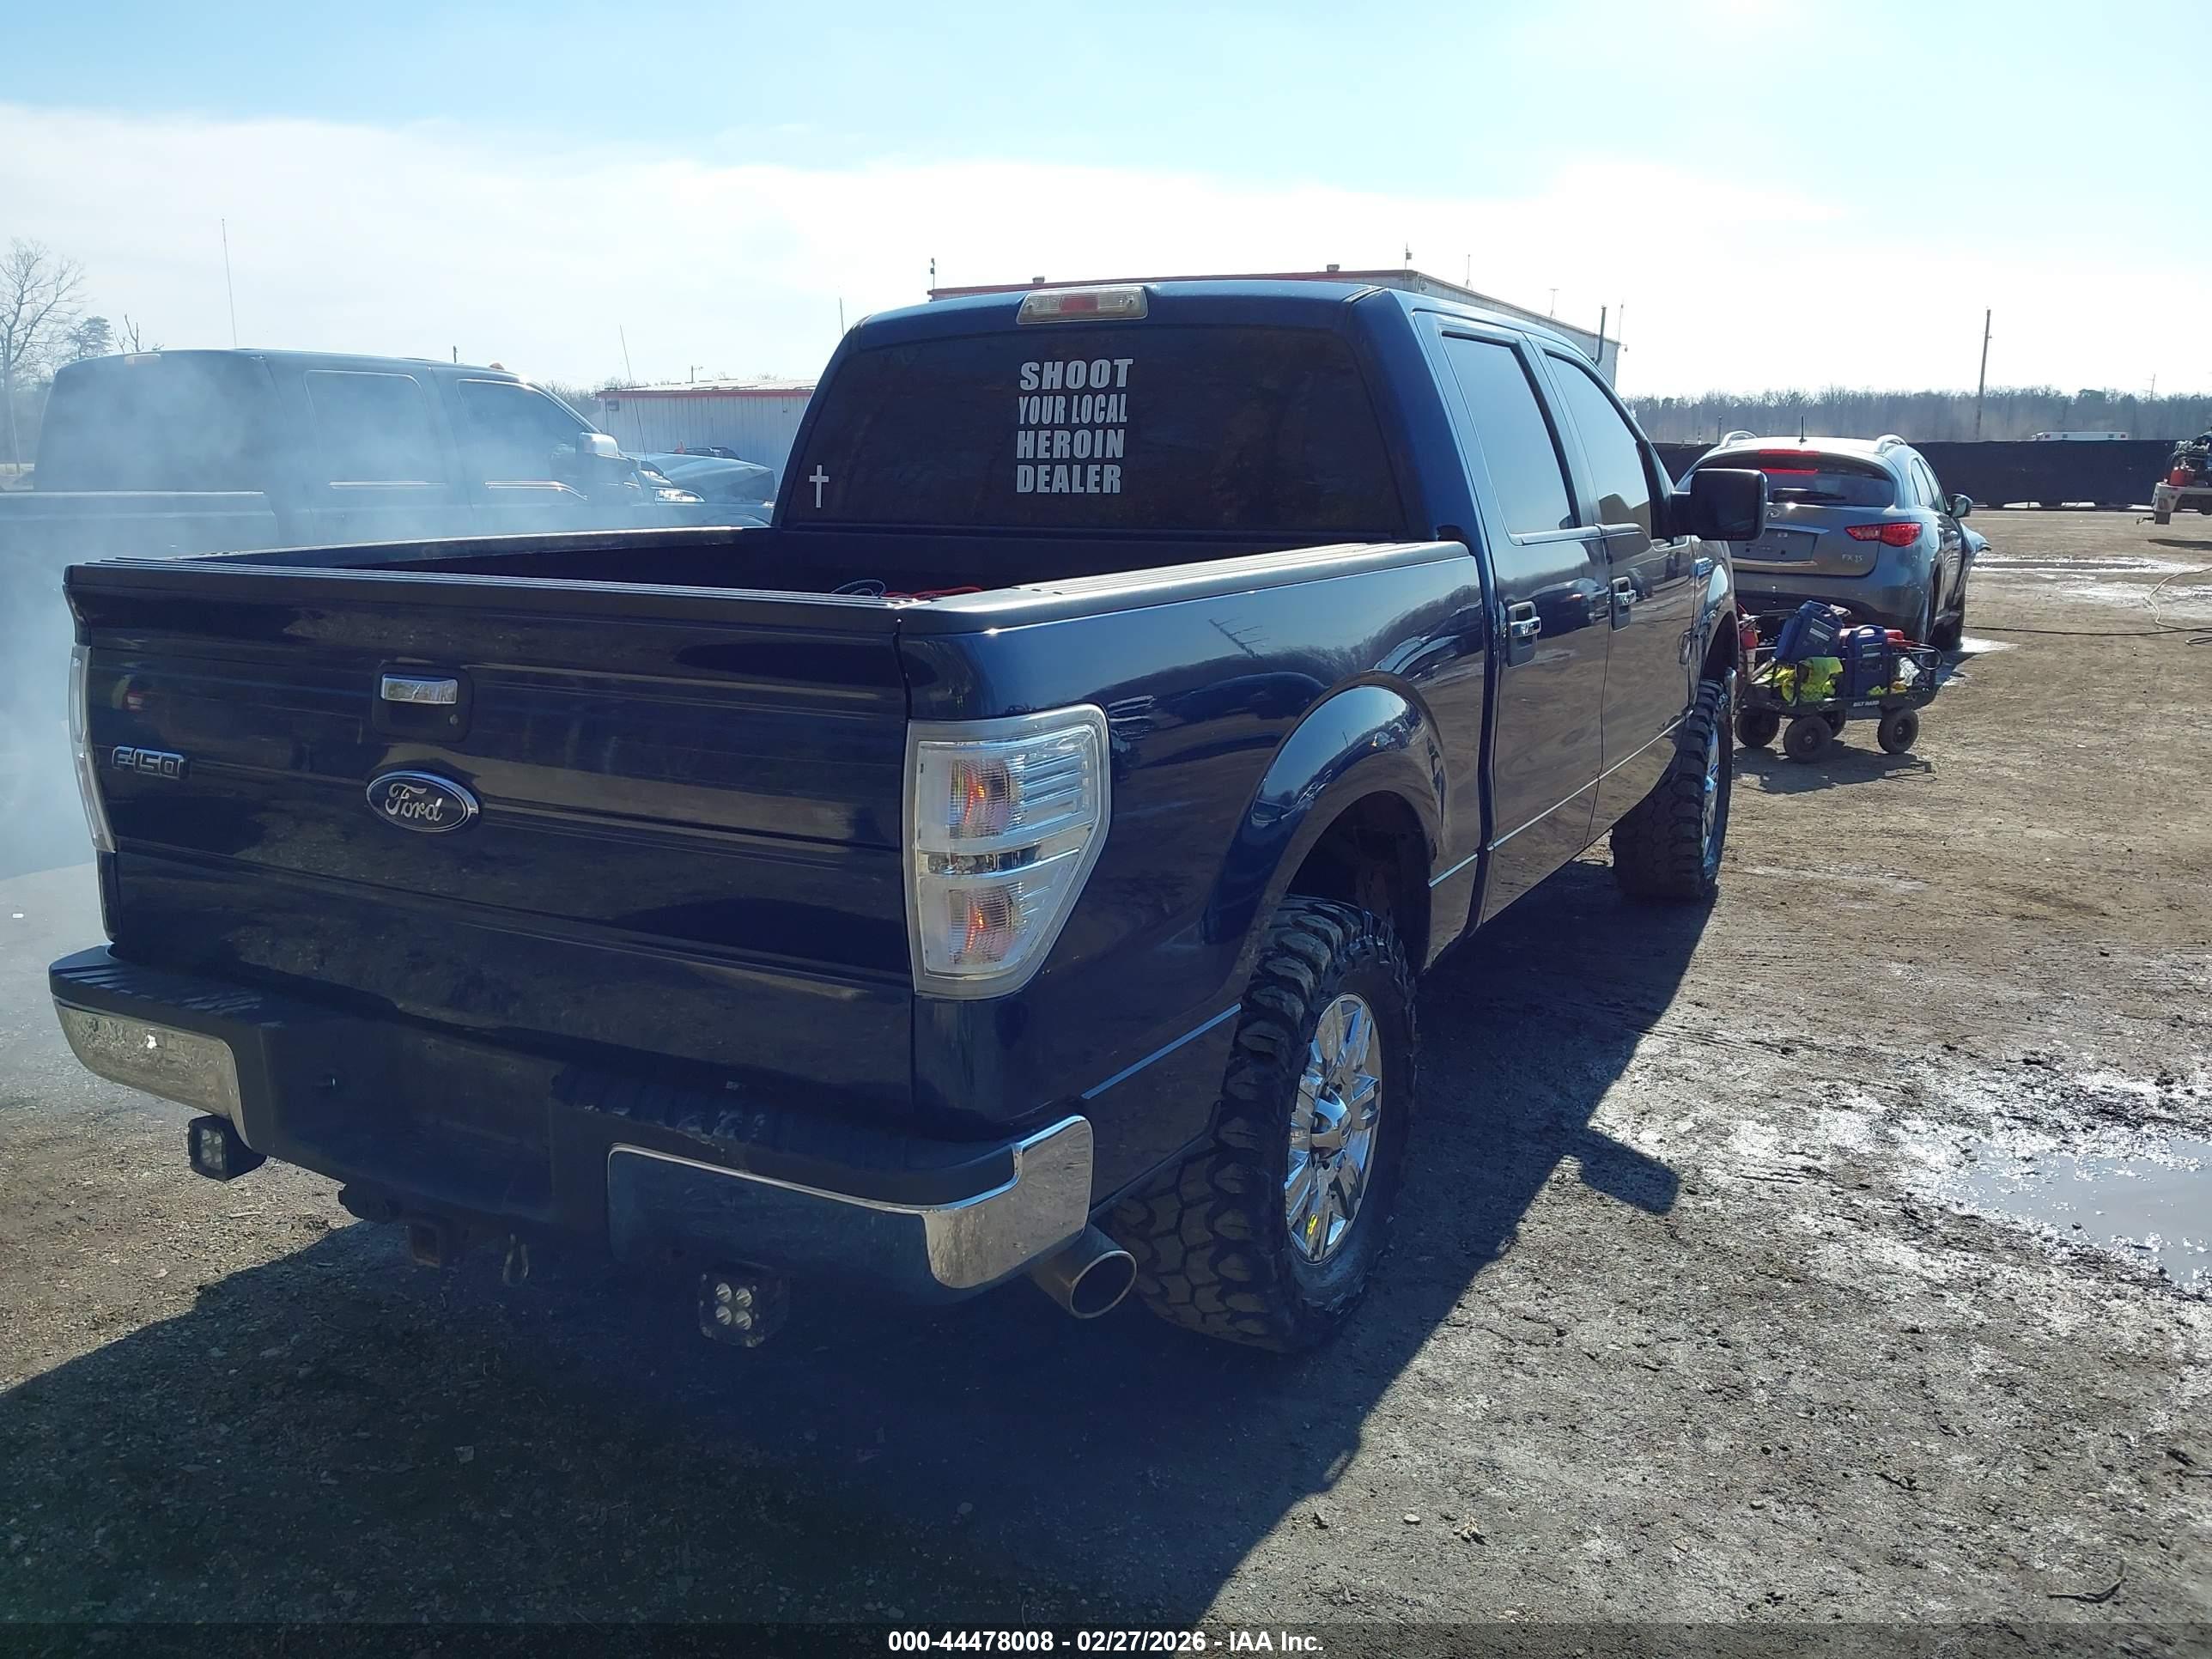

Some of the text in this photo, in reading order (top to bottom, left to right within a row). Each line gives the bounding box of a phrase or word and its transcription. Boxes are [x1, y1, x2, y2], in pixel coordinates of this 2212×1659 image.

[1020, 358, 1133, 391] SHOOT
[1018, 393, 1127, 424] YOUR LOCAL
[1017, 428, 1125, 459] HEROIN
[1017, 465, 1121, 493] DEALER
[385, 782, 443, 821] Ford
